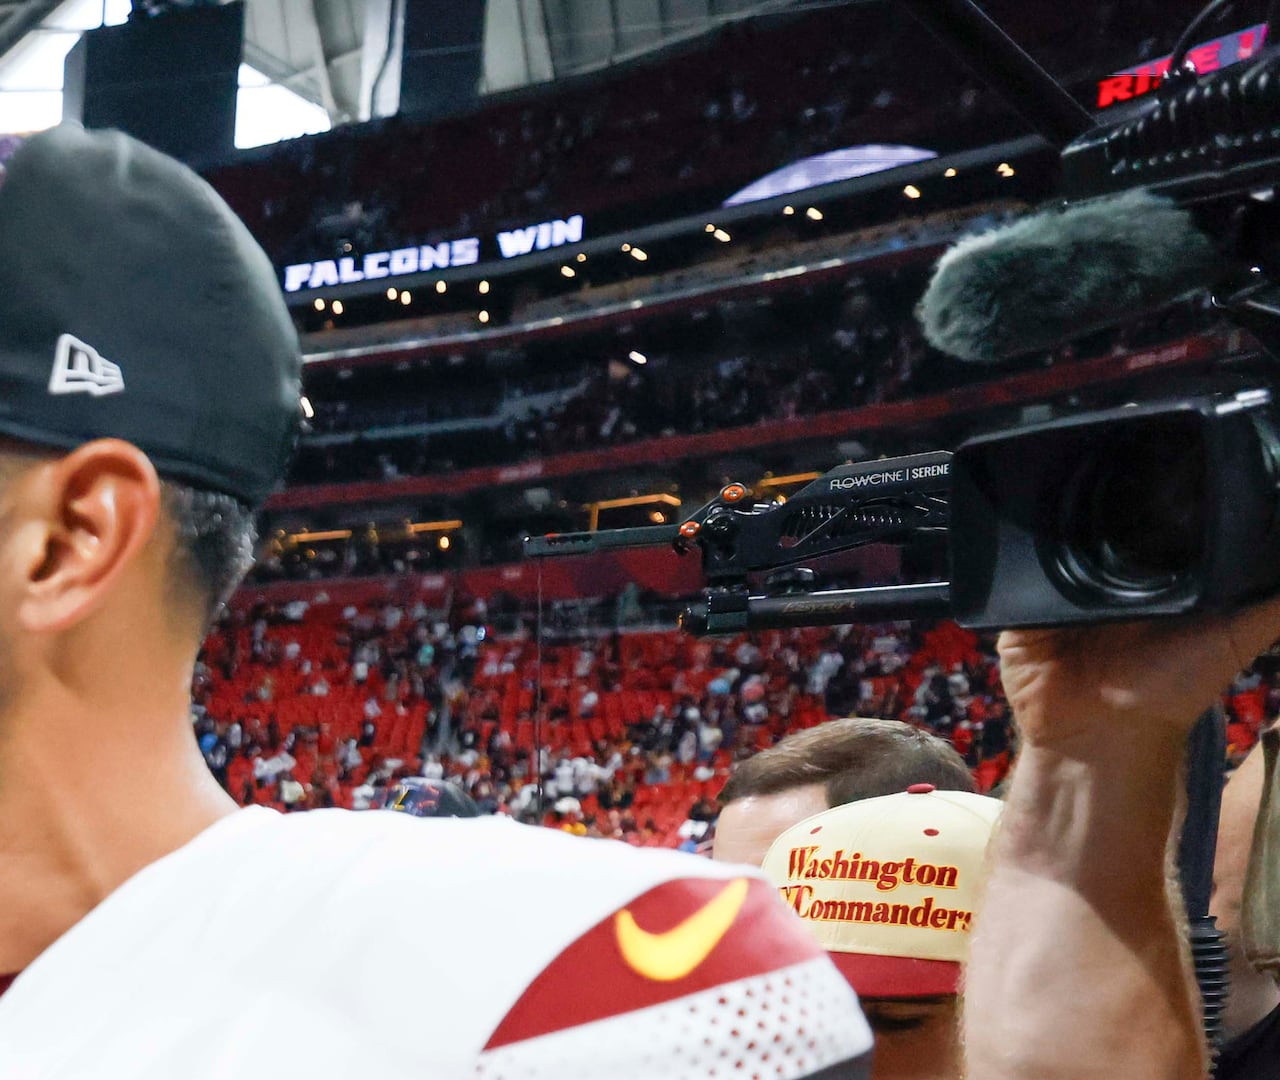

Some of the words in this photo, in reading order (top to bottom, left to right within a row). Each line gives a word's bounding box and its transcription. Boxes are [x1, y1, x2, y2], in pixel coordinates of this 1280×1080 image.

[284, 236, 480, 293] FALCONS
[496, 214, 585, 259] WIN
[911, 463, 950, 479] SERENE
[787, 844, 959, 890] Washington
